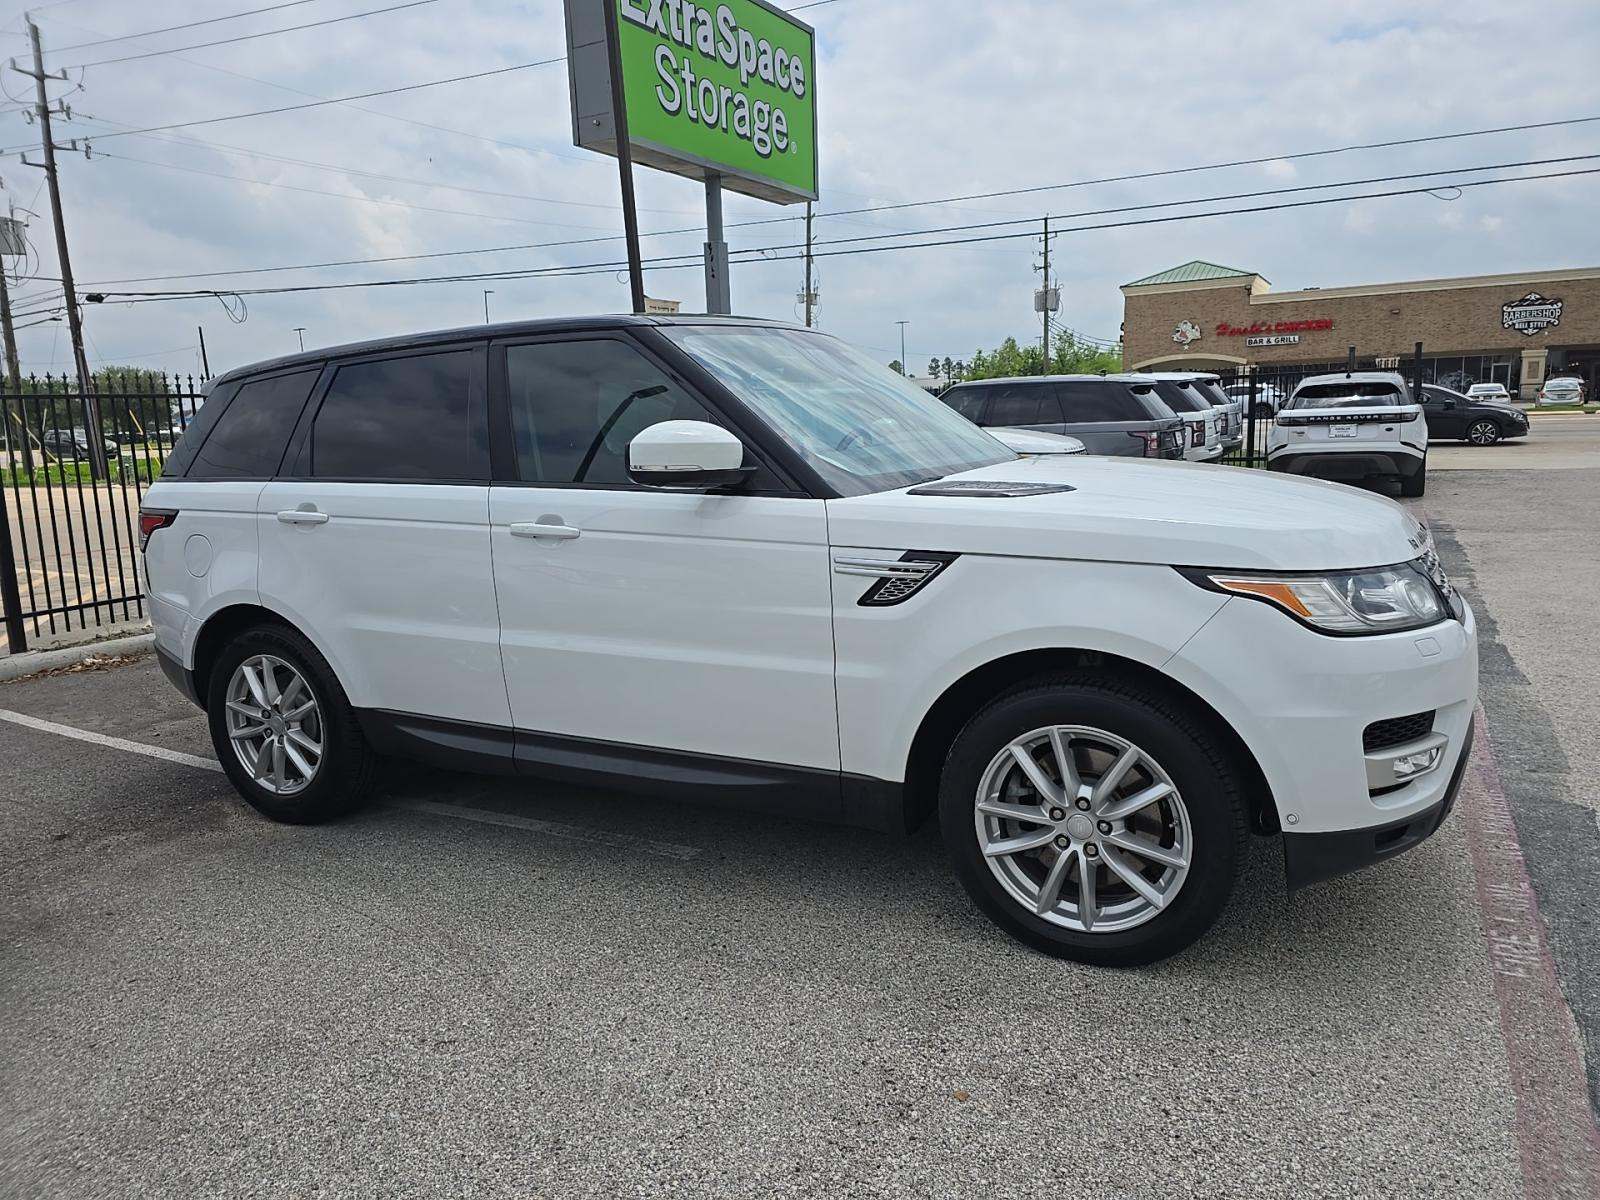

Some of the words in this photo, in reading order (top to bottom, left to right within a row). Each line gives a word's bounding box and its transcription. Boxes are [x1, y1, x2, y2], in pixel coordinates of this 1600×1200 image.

[1503, 309, 1561, 323] BARBERSHOP
[1247, 338, 1264, 346] BAR
[1274, 336, 1298, 345] GRILL
